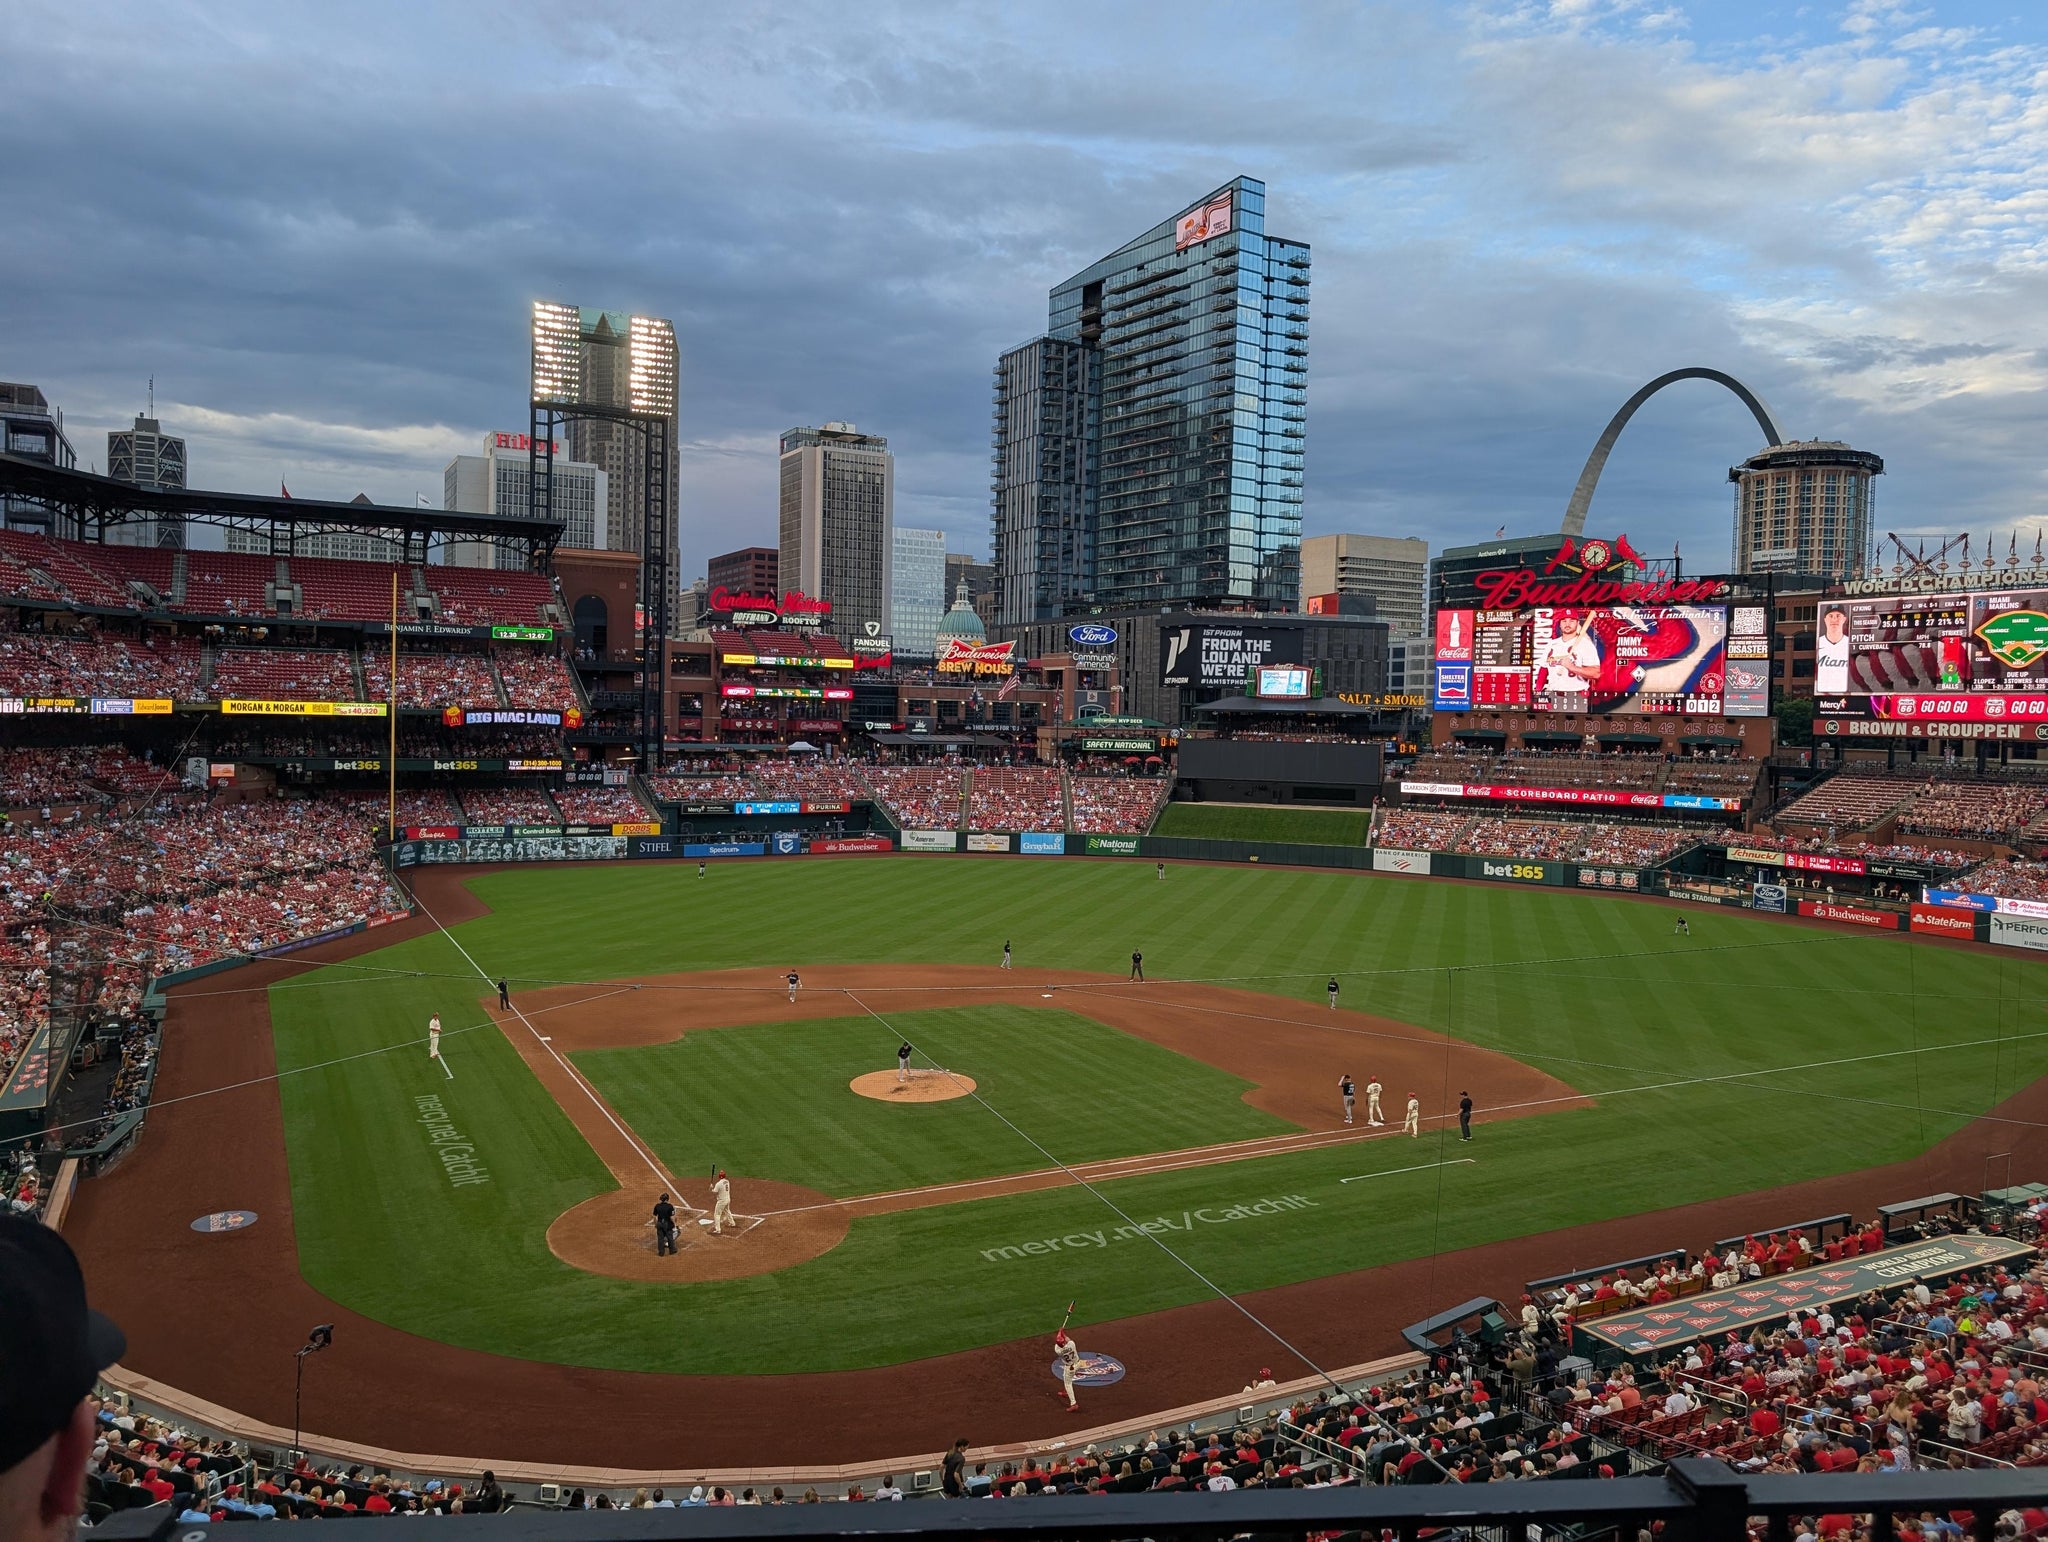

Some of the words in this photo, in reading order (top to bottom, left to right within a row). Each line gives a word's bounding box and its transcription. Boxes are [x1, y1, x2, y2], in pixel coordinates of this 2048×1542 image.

[1478, 549, 1497, 557] Anthem
[1843, 577, 1919, 594] WORLD
[1917, 569, 2048, 591] CHAMPIONS
[1474, 569, 1722, 608] Budweiser
[710, 585, 778, 612] Cardinals
[775, 591, 832, 616] Nation
[1989, 596, 2010, 604] MIAMI
[732, 611, 770, 621] HOFFMANN
[782, 616, 821, 626] ROOFTOP
[1882, 620, 1897, 628] 35.0
[1954, 617, 1965, 625] 6%
[384, 623, 425, 633] BENJAMIN
[426, 625, 432, 633] F.
[434, 624, 472, 634] EDWARDS
[1080, 626, 1108, 642] Ford
[854, 638, 890, 648] FANDUEL
[1617, 636, 1642, 647] JIMMY
[1852, 634, 1874, 642] PITCH
[1202, 639, 1242, 651] FROM
[1244, 639, 1272, 652] THE
[1728, 645, 1768, 654] DISASTER
[940, 644, 1014, 661] Budweiser
[1438, 647, 1469, 658] Coca-Cola
[1617, 647, 1648, 657] CROOKS
[1072, 652, 1116, 664] Community
[1201, 652, 1232, 664] LOU
[1232, 652, 1261, 664] AND
[938, 662, 973, 673] BREW
[974, 662, 1014, 675] HOUSE
[1201, 664, 1244, 676] WE'RE
[1338, 693, 1371, 706] SALT
[1384, 694, 1426, 706] SMOKE
[1820, 700, 1841, 710] Mercy
[16, 703, 21, 712] 2
[230, 702, 263, 713] MORGAN
[265, 703, 271, 712] &
[273, 703, 305, 713] MORGAN
[1689, 702, 1694, 710] 0
[1712, 702, 1718, 710] 2
[1900, 704, 1914, 713] 66
[1921, 701, 1934, 713] GO
[1937, 701, 1950, 713] GO
[1953, 701, 1967, 713] GO
[1986, 705, 2004, 715] 66
[2011, 701, 2026, 714] GO
[2028, 701, 2044, 714] GO
[466, 712, 492, 724] BIG
[493, 712, 526, 723] MAC
[526, 712, 561, 725] LAND
[1470, 720, 1474, 730] 1
[1481, 720, 1489, 730] 2
[1495, 720, 1503, 730] 6
[1510, 720, 1518, 731] 9
[1525, 720, 1537, 731] 10
[1544, 720, 1557, 731] 14
[1565, 721, 1576, 732] 17
[1584, 721, 1600, 732] 20
[1610, 721, 1627, 733] 23
[1633, 722, 1650, 733] 24
[1659, 722, 1675, 734] 42
[1684, 723, 1701, 734] 45
[1708, 723, 1725, 735] 85
[1850, 722, 1907, 735] BROWN
[1912, 726, 1922, 734] &
[1926, 723, 2020, 738] CROUPPEN
[1114, 742, 1151, 750] NATIONAL
[1400, 744, 1417, 753] 0:14
[334, 760, 381, 770] bet365
[434, 760, 478, 770] bet365
[1467, 786, 1491, 796] Coca-Cola
[1506, 789, 1578, 799] SCOREBOARD
[1583, 794, 1616, 802] PATIO
[1631, 795, 1658, 805] Coca-Cola
[774, 832, 798, 840] CarShield
[639, 841, 672, 853] STIFEL
[838, 843, 878, 851] Budweiser
[1099, 839, 1136, 849] National
[1731, 849, 1780, 861] Schnucks
[1484, 862, 1544, 880] bet365
[1871, 867, 1889, 875] Mercy
[1669, 890, 1690, 900] BUSCH
[1692, 892, 1721, 904] STADIUM
[1759, 887, 1780, 898] Ford
[1828, 908, 1881, 924] Budweiser
[414, 1094, 490, 1188] mercy.net/CatchIt
[979, 1193, 1321, 1262] mercy.net/CatchIt
[1859, 1255, 1908, 1272] WORLD
[1903, 1247, 1947, 1262] SERIES
[1875, 1251, 1967, 1279] CHAMPIONS
[1744, 1291, 1764, 1299] 1964
[1700, 1301, 1721, 1310] 1944
[1736, 1306, 1757, 1314] 1946
[1653, 1313, 1673, 1321] 1934
[1690, 1317, 1712, 1326] 1942
[1606, 1324, 1628, 1334] 1926
[1644, 1329, 1663, 1338] 1931
[1063, 1351, 1076, 1364] 27
